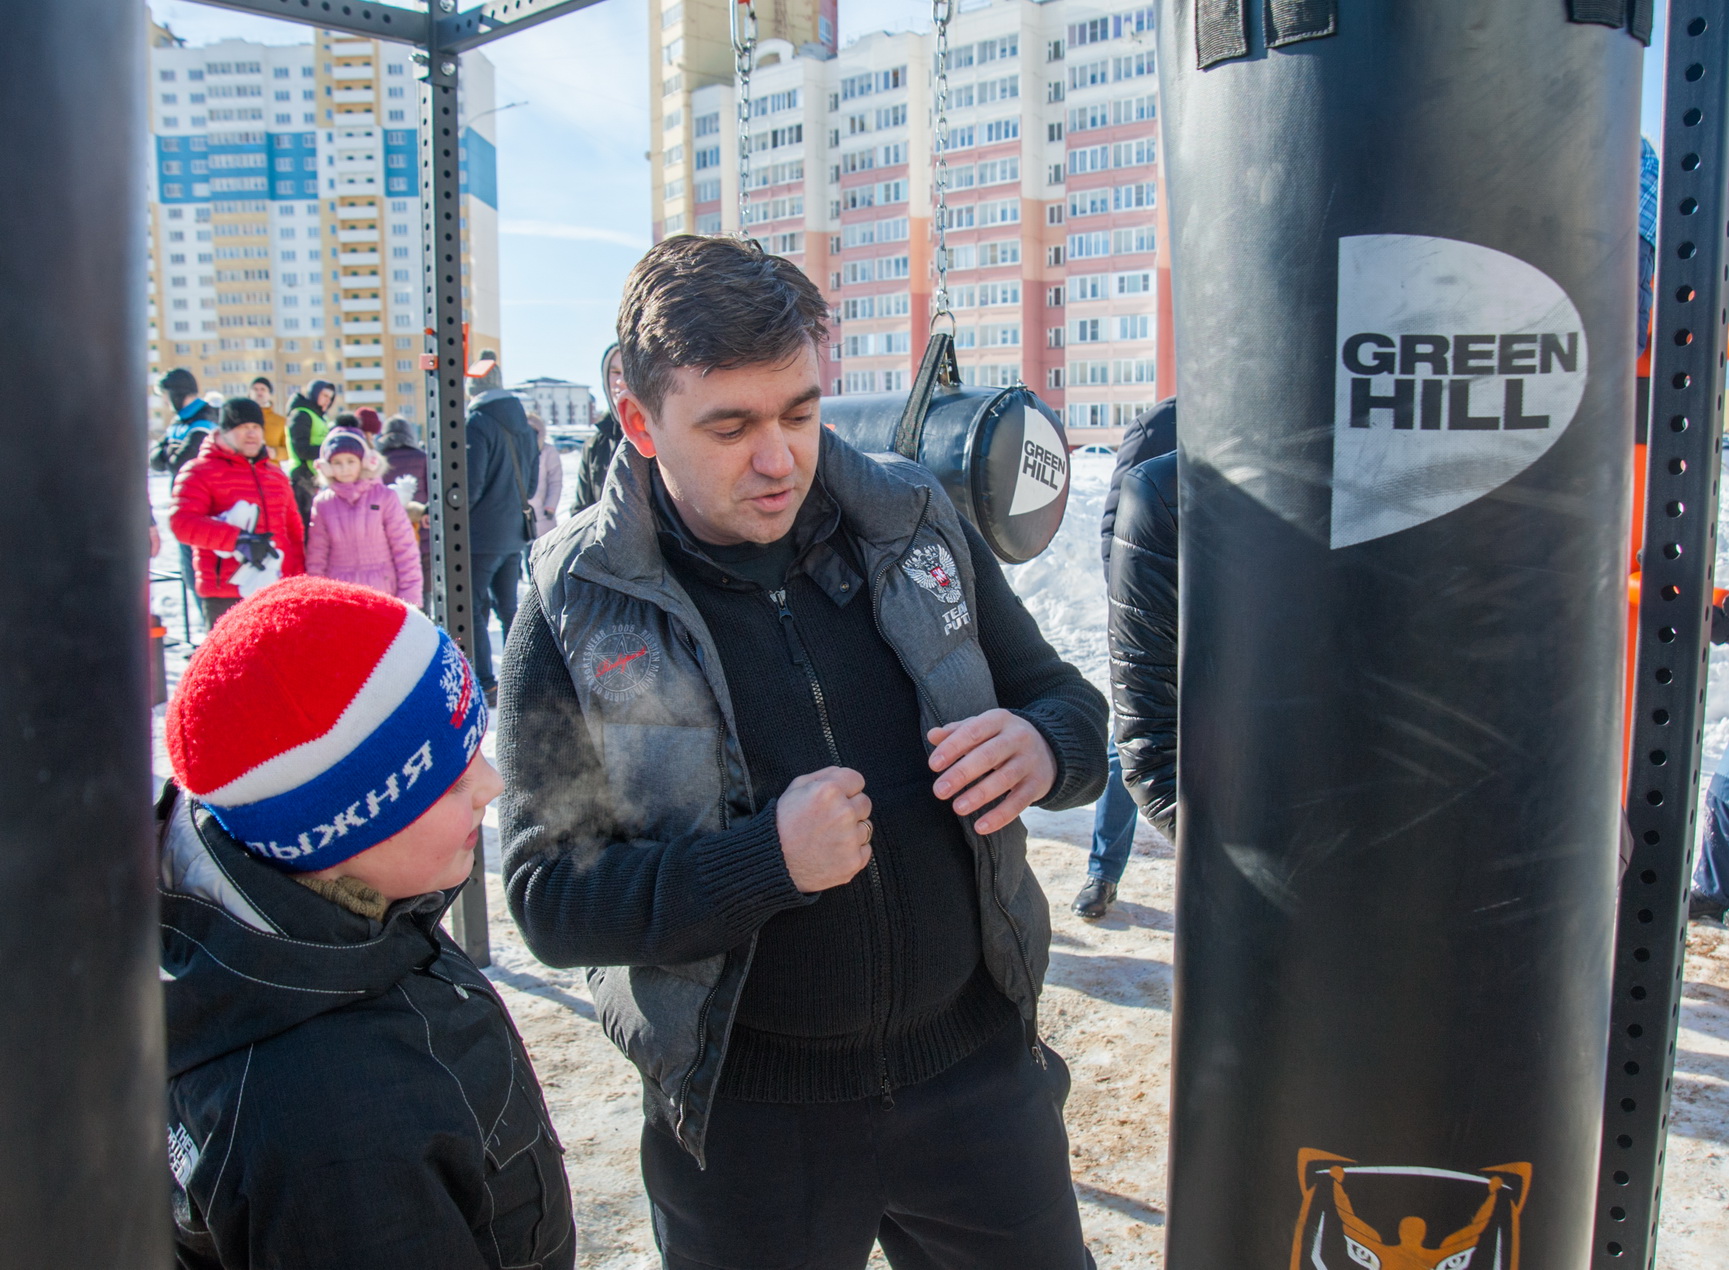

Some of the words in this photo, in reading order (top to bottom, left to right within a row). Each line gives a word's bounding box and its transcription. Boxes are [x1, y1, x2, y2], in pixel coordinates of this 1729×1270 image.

[1342, 332, 1578, 376] GREEN
[1350, 377, 1550, 431] HILL
[1022, 455, 1058, 491] HILL
[1024, 440, 1065, 475] GREEN
[583, 629, 607, 687] SPORTSWEAR
[640, 629, 660, 662] RUSSIAN
[176, 1121, 194, 1153] THE
